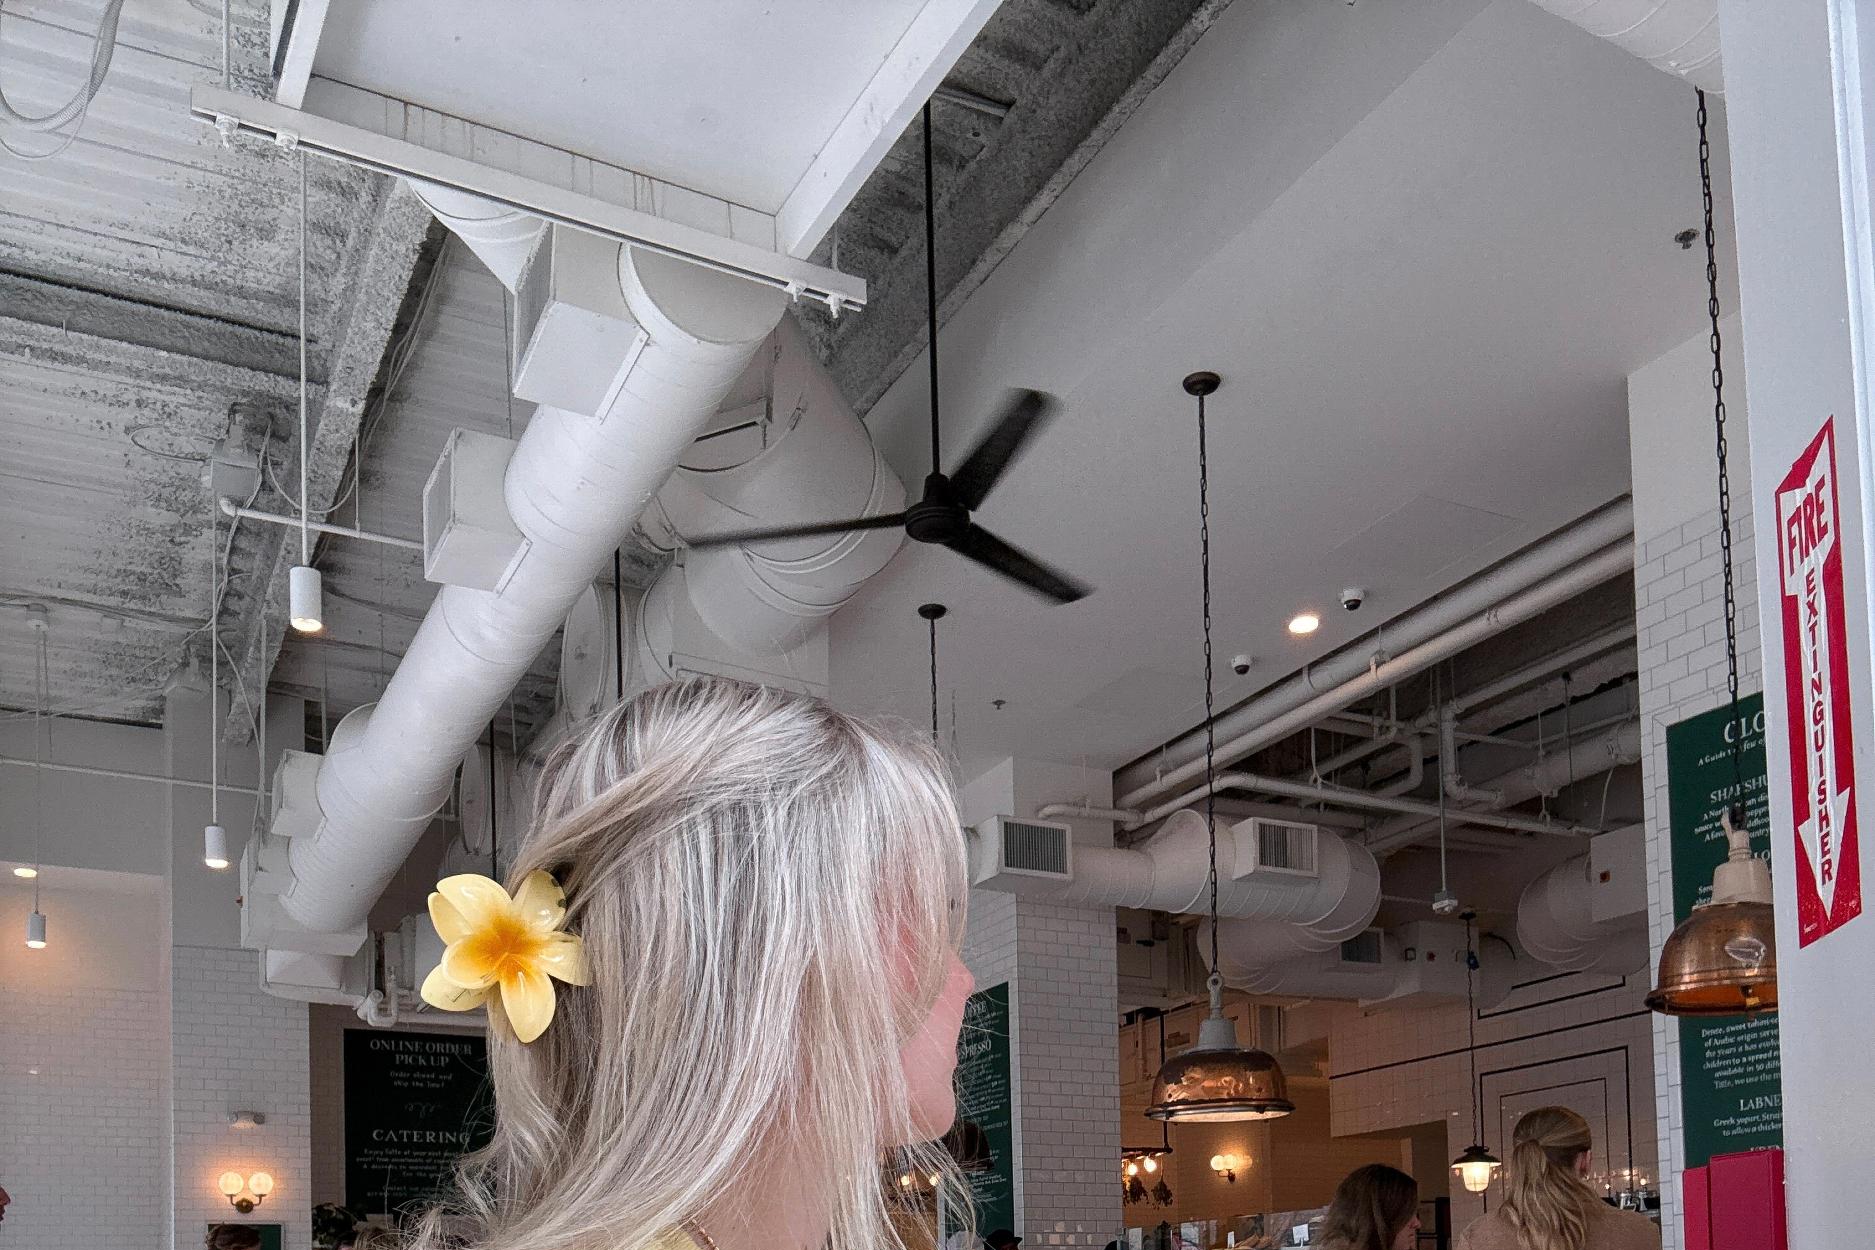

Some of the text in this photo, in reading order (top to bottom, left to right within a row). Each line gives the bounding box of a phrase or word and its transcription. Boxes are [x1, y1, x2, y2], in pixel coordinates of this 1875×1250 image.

[1786, 473, 1829, 578] FIRE
[1805, 566, 1834, 887] EXTINGUISHER
[370, 1039, 472, 1056] ONLINE ORDER
[395, 1053, 449, 1067] PICK UP
[372, 1129, 470, 1144] CATERING
